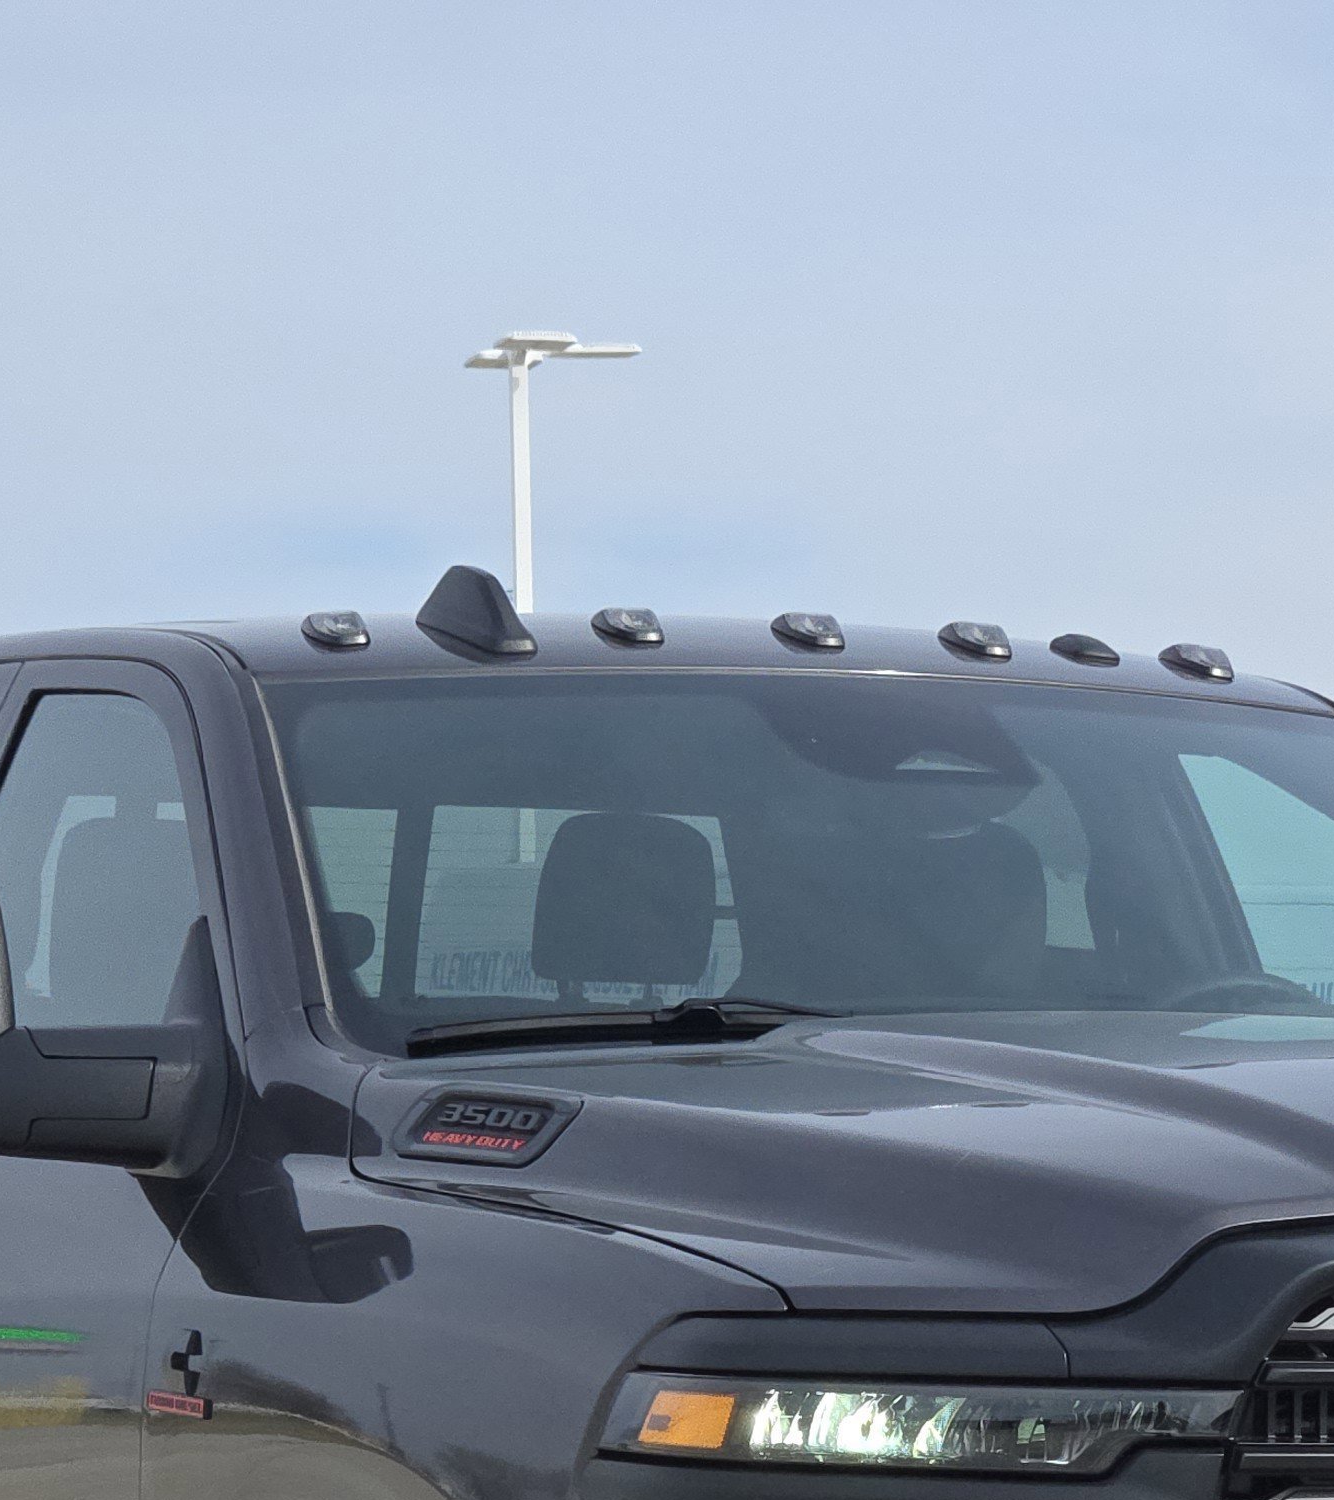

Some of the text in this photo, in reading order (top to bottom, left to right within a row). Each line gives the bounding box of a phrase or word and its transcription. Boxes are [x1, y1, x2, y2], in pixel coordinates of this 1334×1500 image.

[437, 1103, 539, 1130] 3500
[423, 1131, 527, 1150] HEAVY DUTY
